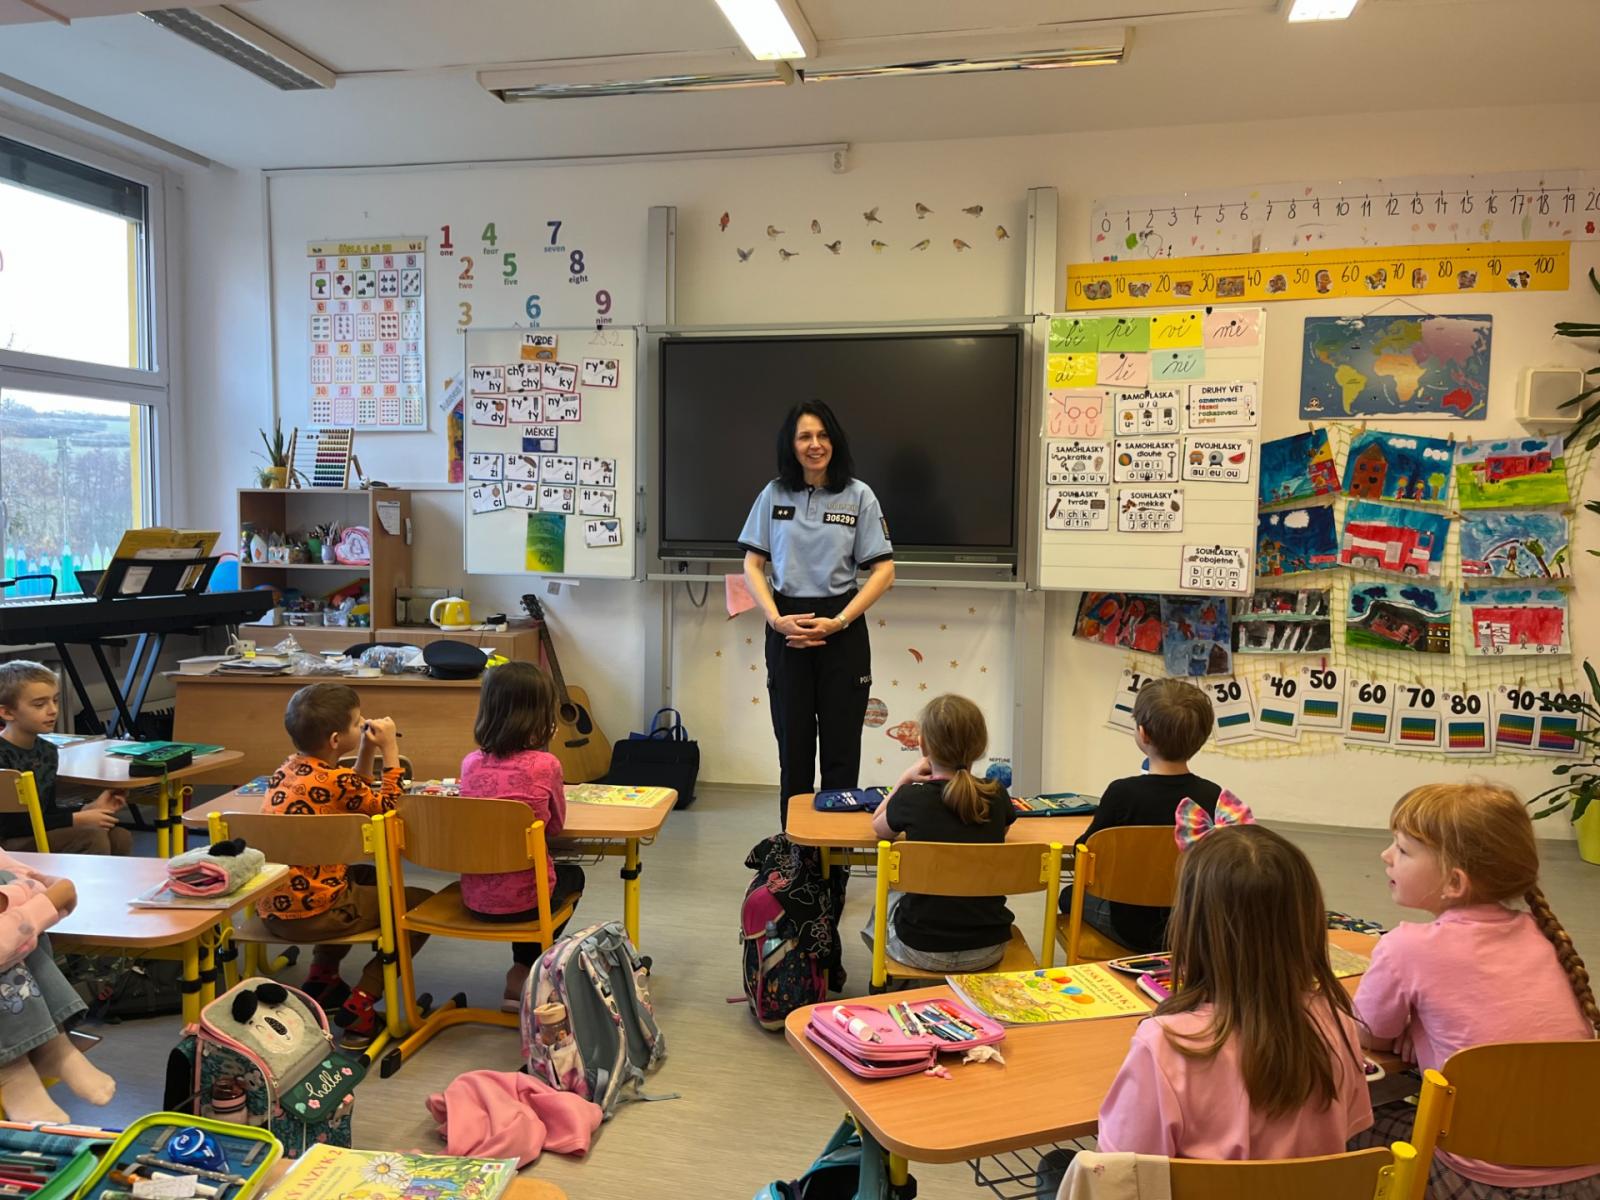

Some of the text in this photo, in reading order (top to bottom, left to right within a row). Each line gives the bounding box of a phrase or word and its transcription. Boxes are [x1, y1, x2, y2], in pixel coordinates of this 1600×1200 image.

[1102, 219, 1111, 233] 0
[1146, 213, 1154, 228] 2
[1168, 211, 1178, 226] 3
[1194, 208, 1202, 224] 4
[1216, 208, 1224, 223] 5
[1240, 206, 1248, 221] 6
[1266, 205, 1273, 221] 7
[1288, 203, 1296, 219] 8
[1313, 201, 1320, 216] 9
[1336, 202, 1350, 216] 10
[1361, 200, 1371, 216] 11
[1386, 199, 1400, 216] 12
[1411, 198, 1424, 215] 13
[1435, 198, 1447, 214] 14
[1461, 197, 1473, 214] 15
[1486, 198, 1498, 214] 16
[1510, 195, 1525, 215] 17
[1537, 195, 1550, 215] 18
[1563, 194, 1576, 213] 19
[440, 225, 453, 249] 1
[482, 223, 497, 246] 4
[547, 221, 562, 245] 7
[460, 256, 474, 280] 2
[503, 253, 517, 277] 5
[570, 250, 585, 274] 8
[569, 275, 588, 284] eight
[1075, 258, 1554, 296] 0 10 20 30 40 50 60 70 80 90 100
[526, 295, 541, 319] 6
[596, 290, 611, 315] 9
[458, 302, 473, 326] 3
[473, 369, 485, 380] hy
[545, 364, 557, 376] ky
[586, 362, 598, 372] ry
[1202, 386, 1226, 394] DRUHY
[476, 400, 488, 412] dy
[512, 398, 522, 410] ty
[548, 397, 560, 407] ny
[826, 514, 856, 525] 306299
[1270, 677, 1297, 698] 40
[1310, 670, 1337, 690] 50
[1214, 682, 1241, 702] 30
[1359, 684, 1386, 704] 60
[1407, 688, 1435, 708] 70
[1507, 690, 1535, 710] 90
[1451, 695, 1481, 714] 80
[305, 1070, 342, 1097] hello
